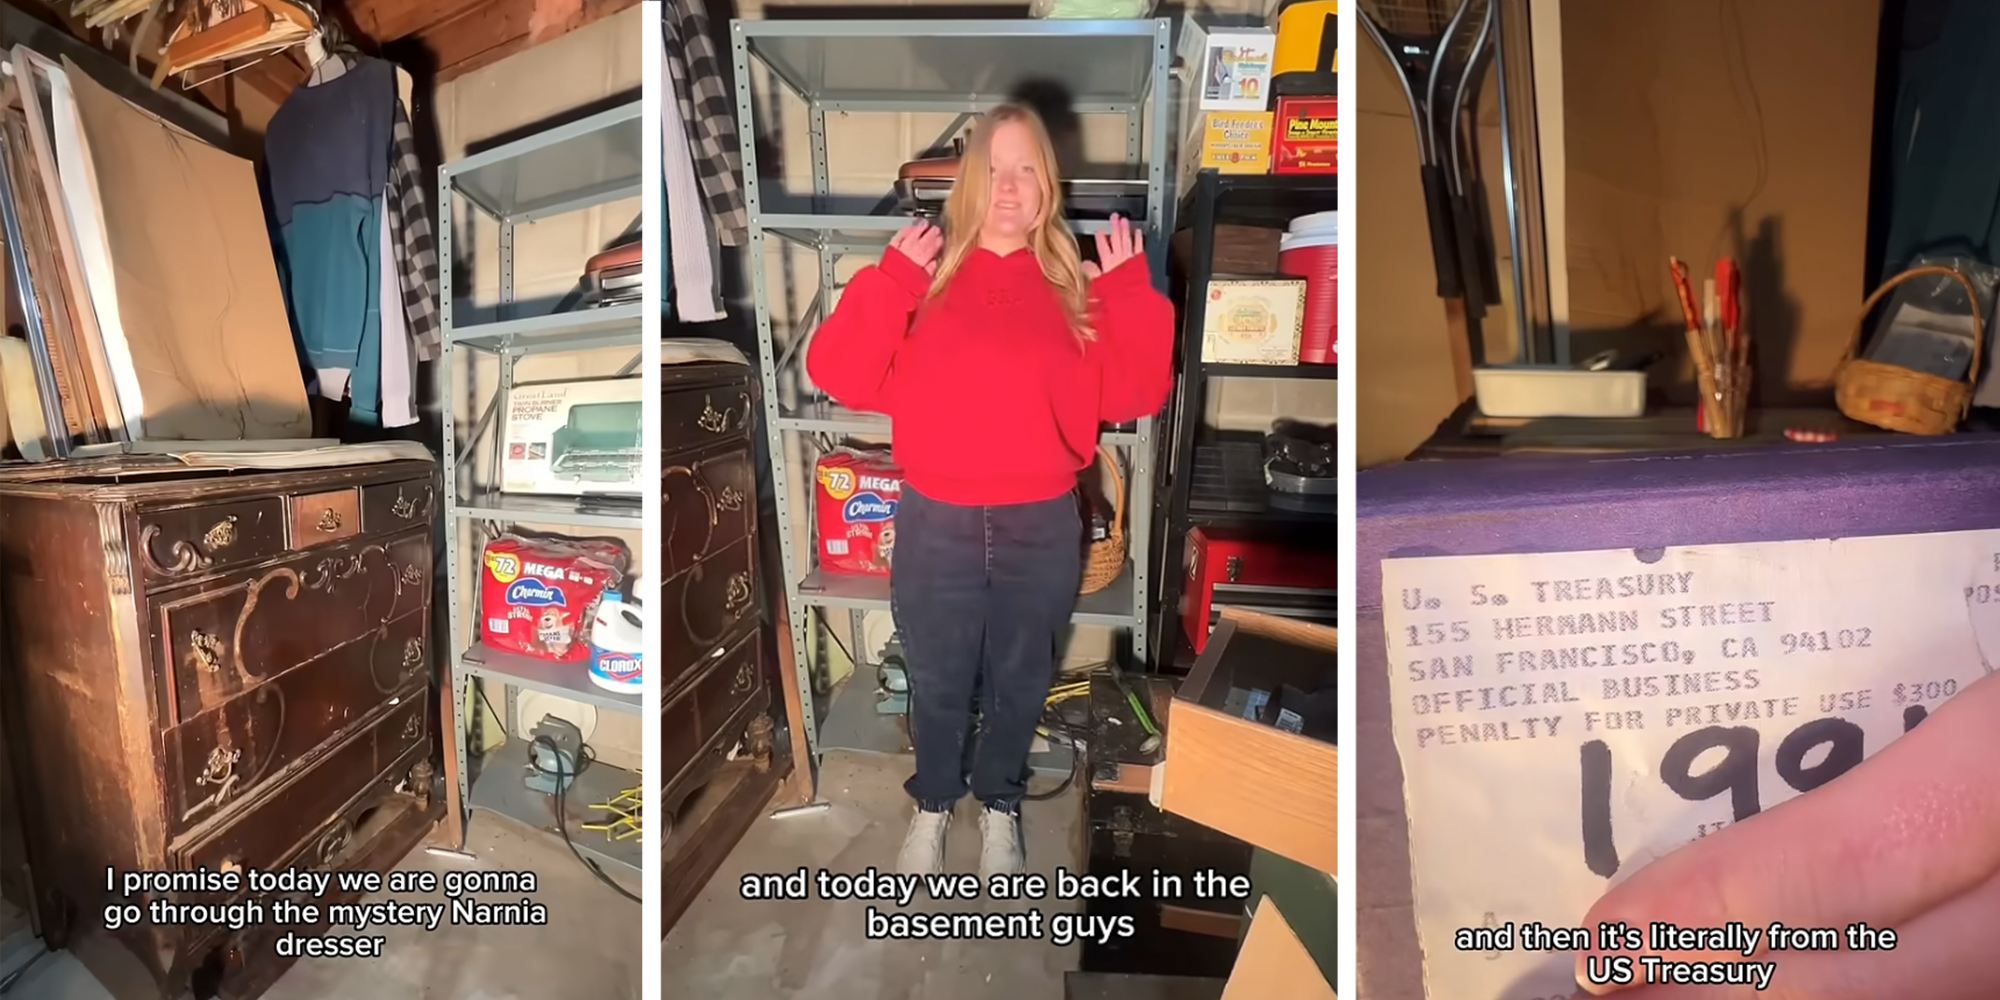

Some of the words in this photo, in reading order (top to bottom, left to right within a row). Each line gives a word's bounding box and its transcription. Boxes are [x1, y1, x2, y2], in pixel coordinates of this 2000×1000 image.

[1238, 77, 1259, 97] 10
[511, 413, 543, 421] STOVE
[512, 405, 558, 414] PROPANE
[829, 472, 851, 490] 72
[859, 475, 901, 492] MEGA
[848, 500, 892, 517] Charmin
[494, 557, 516, 575] 72
[523, 562, 565, 580] MEGA
[511, 585, 554, 601] Charmin
[1402, 587, 1442, 611] U.
[1470, 583, 1509, 606] S.
[1530, 570, 1694, 603] TREASURY
[1405, 620, 1471, 647] 155
[1491, 609, 1639, 641] HERMANN
[1659, 600, 1776, 630] STREET
[1407, 654, 1474, 682] SAN
[1495, 640, 1696, 675] FRANCISCO,
[1720, 636, 1759, 659] CA
[1779, 626, 1873, 655] 94102
[599, 658, 642, 673] CLOROX
[1411, 681, 1580, 715] OFFICIAL
[1601, 668, 1760, 700] BUSINESS
[1416, 714, 1563, 748] PENALTY
[1583, 709, 1645, 732] FOR
[1665, 696, 1800, 728] PRIVATE
[1819, 688, 1872, 714] USE
[1892, 678, 1957, 706] $300
